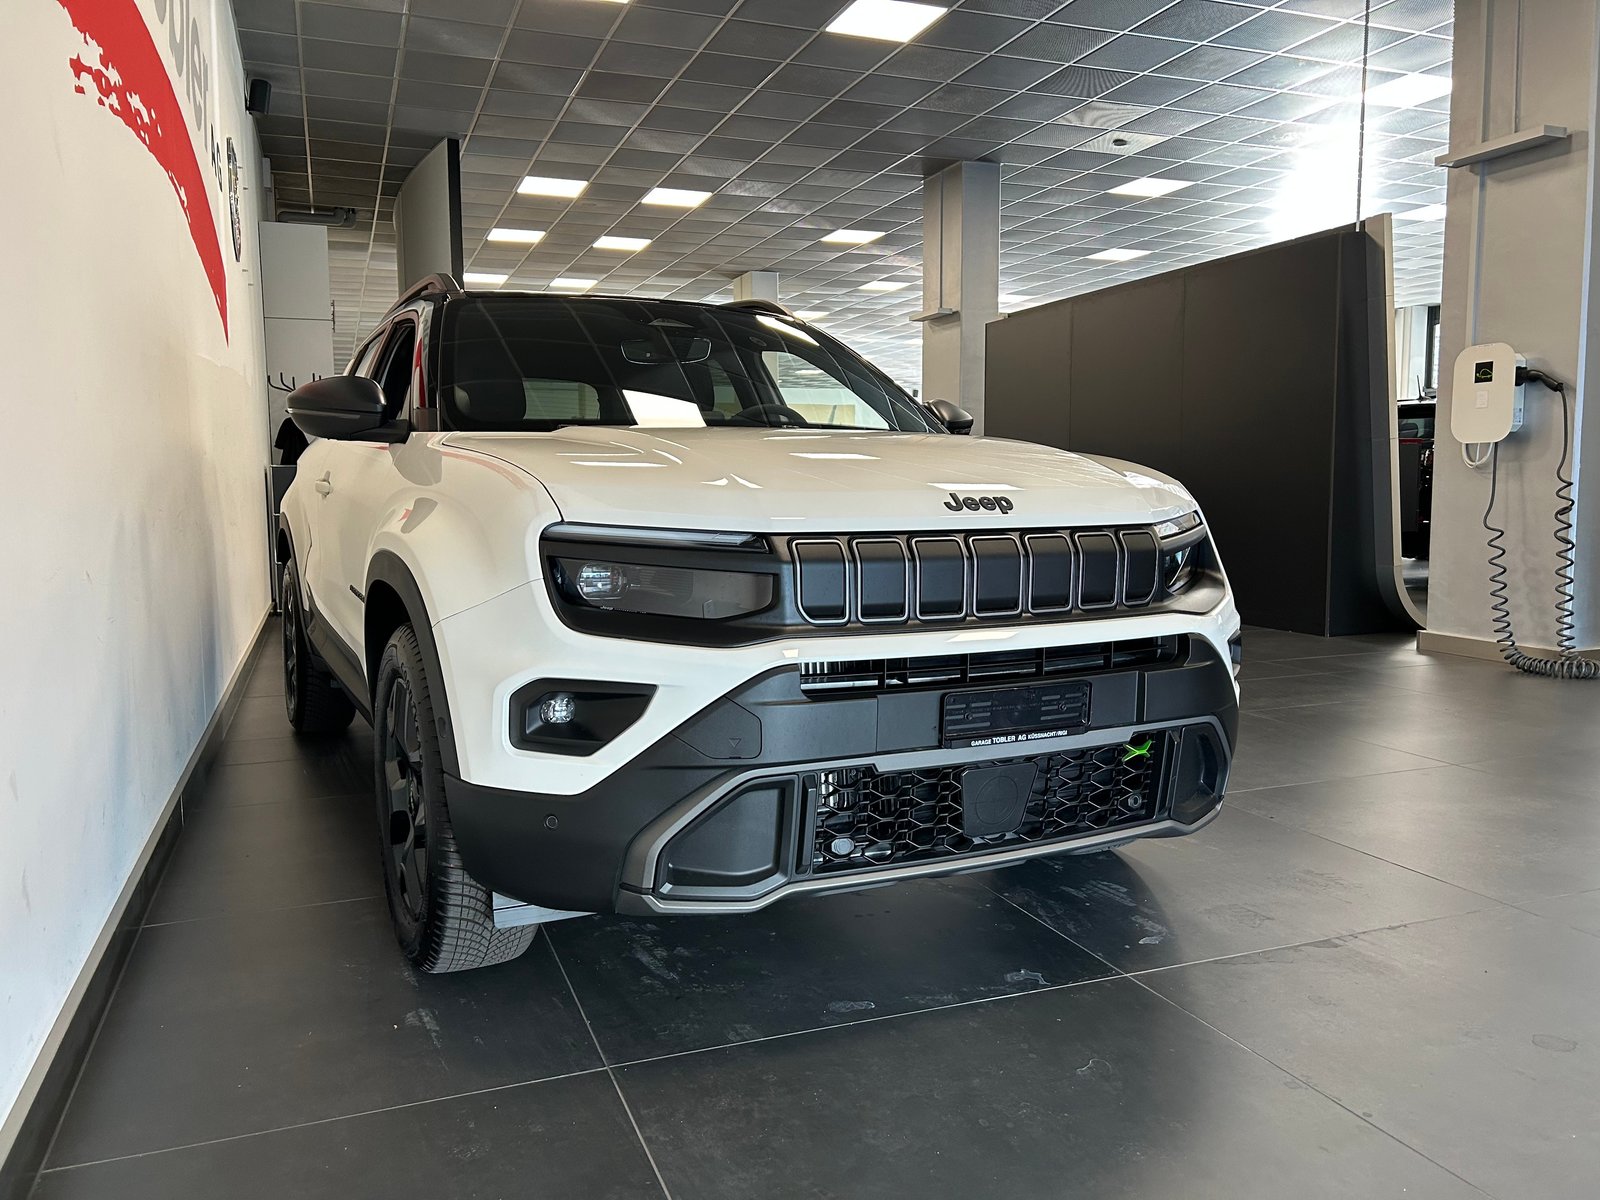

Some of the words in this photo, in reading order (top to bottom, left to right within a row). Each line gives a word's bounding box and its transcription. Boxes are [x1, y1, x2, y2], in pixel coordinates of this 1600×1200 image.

[943, 492, 1014, 515] Jeep
[970, 738, 992, 747] GARAGE
[992, 735, 1016, 744] TOBLER
[1017, 733, 1027, 741] AG
